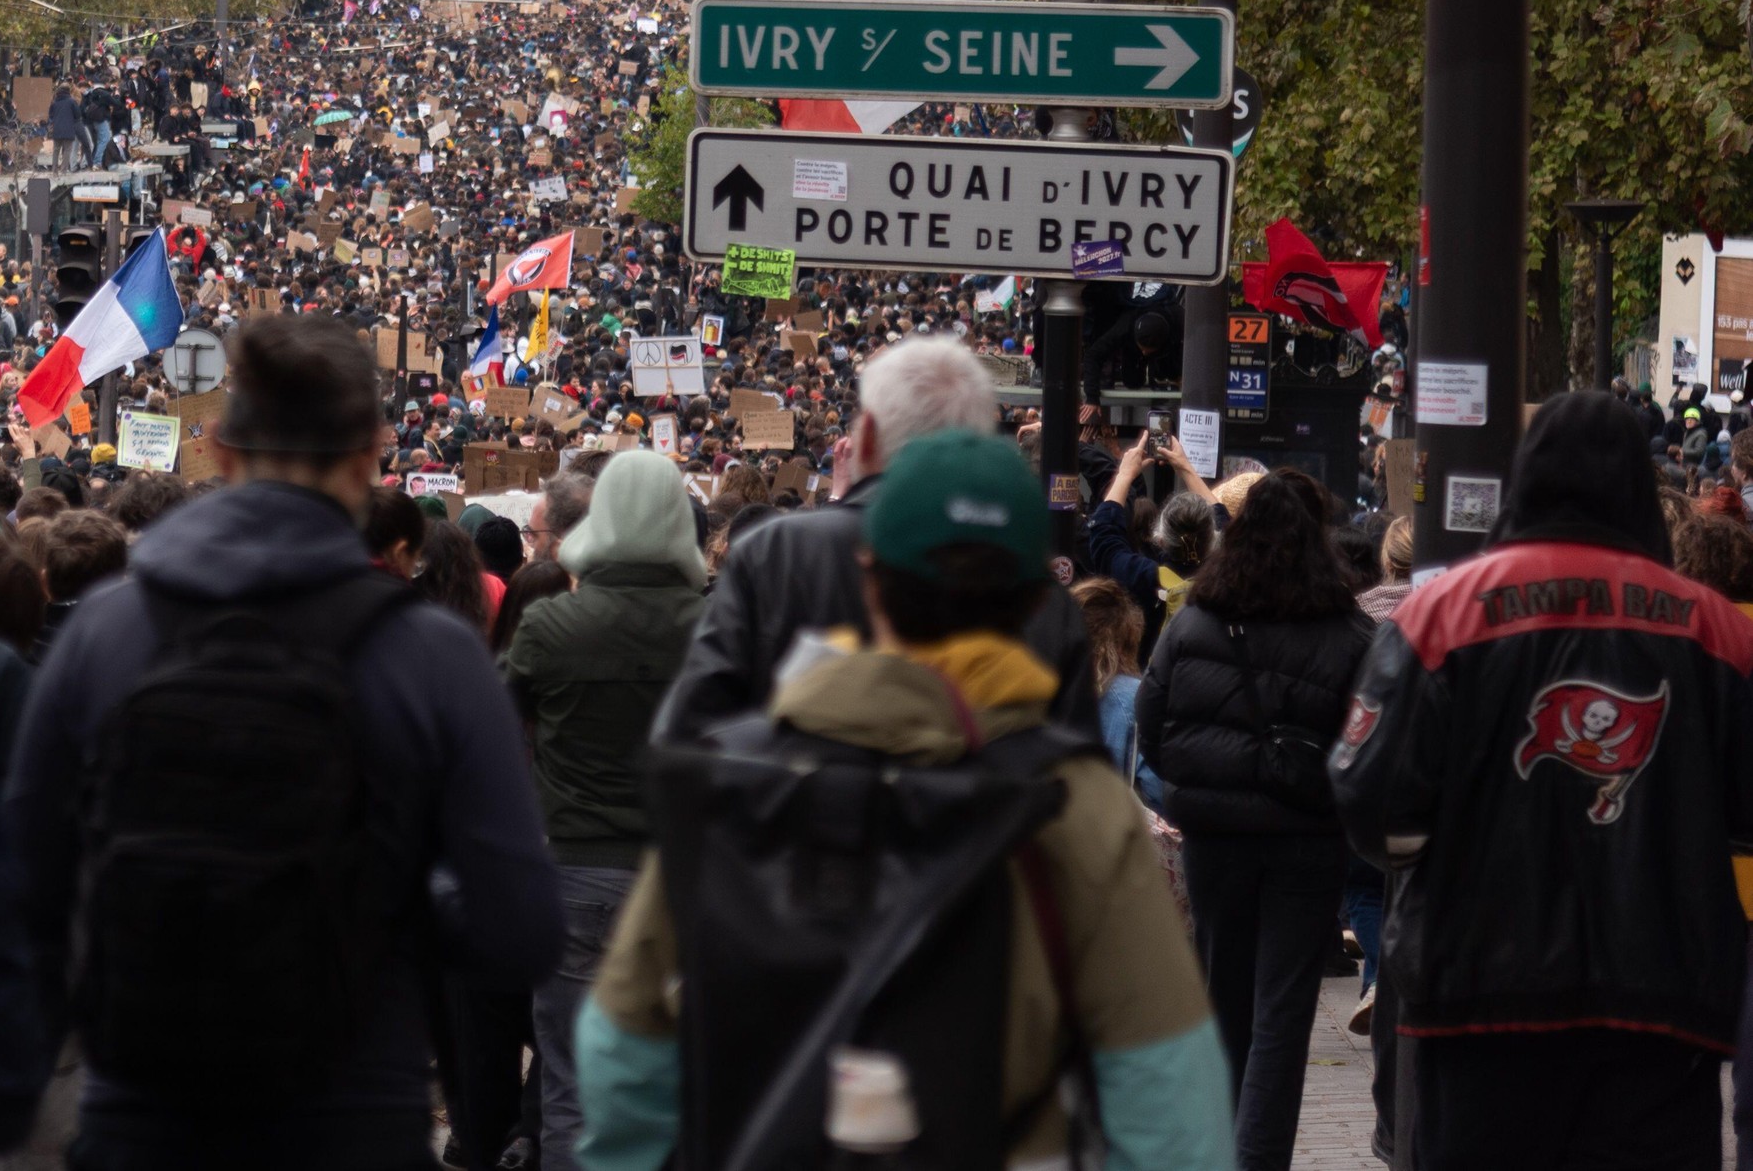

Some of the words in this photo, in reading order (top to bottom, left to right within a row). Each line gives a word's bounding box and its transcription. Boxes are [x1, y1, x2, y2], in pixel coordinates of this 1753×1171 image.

[720, 24, 836, 71] IVRY
[922, 29, 1073, 77] SEINE
[889, 161, 1011, 202] QUAI
[795, 208, 951, 249] PORTE
[977, 228, 1012, 251] DE
[1039, 218, 1200, 260] BERCY
[1234, 320, 1263, 340] 27
[1185, 413, 1203, 425] ACTE
[1204, 415, 1213, 426] III
[427, 477, 456, 487] MACRON
[1477, 578, 1614, 627] TAMPA
[1622, 582, 1695, 628] BAY
